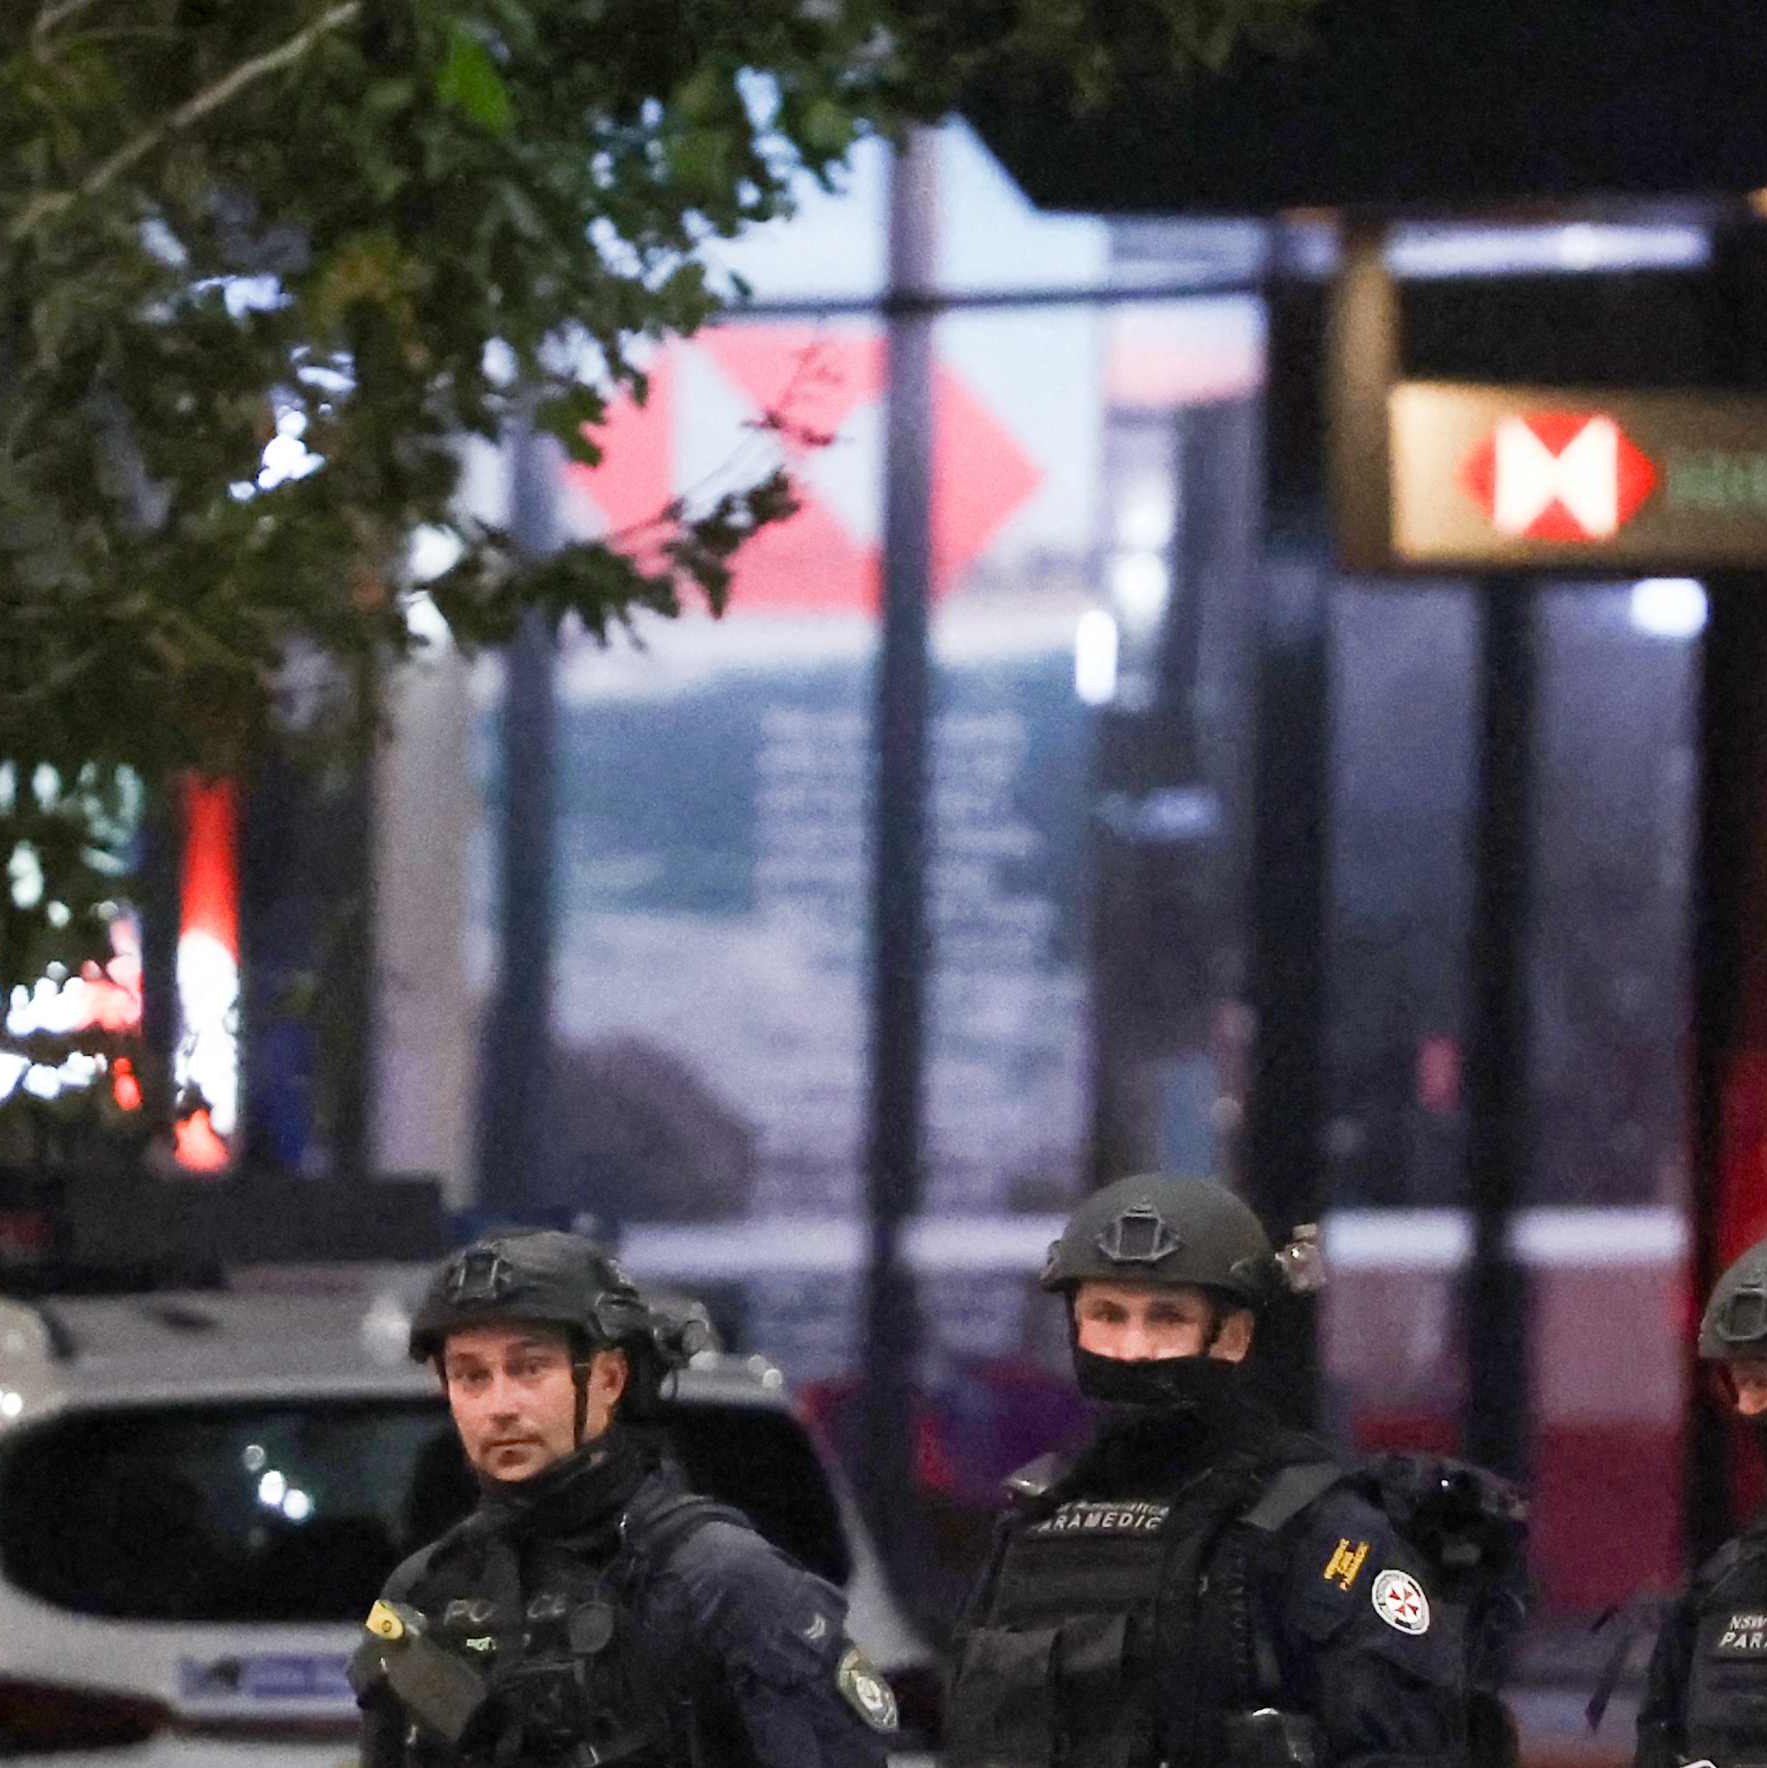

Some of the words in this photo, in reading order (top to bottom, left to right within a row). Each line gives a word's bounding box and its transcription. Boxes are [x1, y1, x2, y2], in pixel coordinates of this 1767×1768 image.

[1031, 1512, 1162, 1533] ARAMEDIC
[443, 1594, 566, 1626] POCE
[1730, 1615, 1767, 1630] NSW
